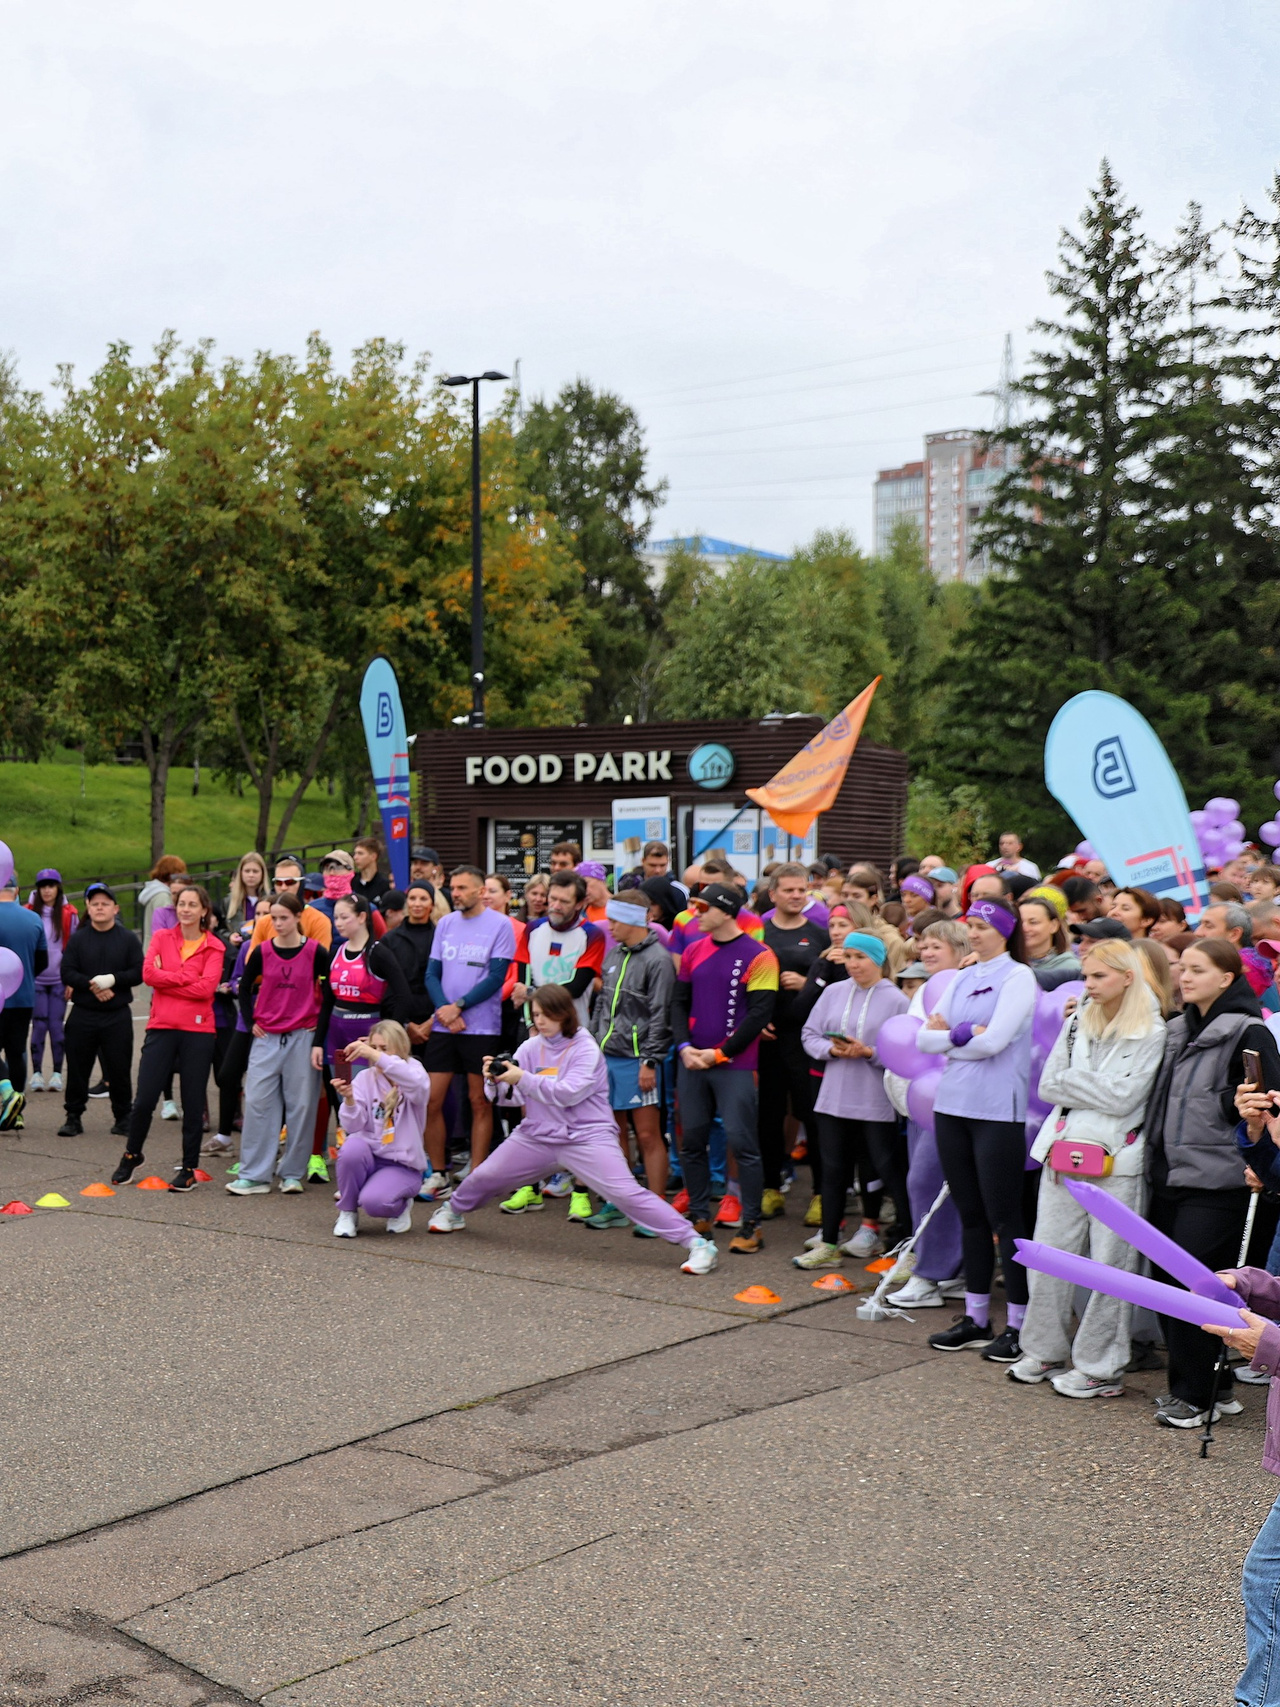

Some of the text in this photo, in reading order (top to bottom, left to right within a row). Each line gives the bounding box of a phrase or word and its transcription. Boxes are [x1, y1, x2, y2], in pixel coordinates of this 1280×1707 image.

[465, 750, 673, 785] FOOD PARK
[340, 970, 349, 982] 2
[339, 984, 360, 997] ВТБ
